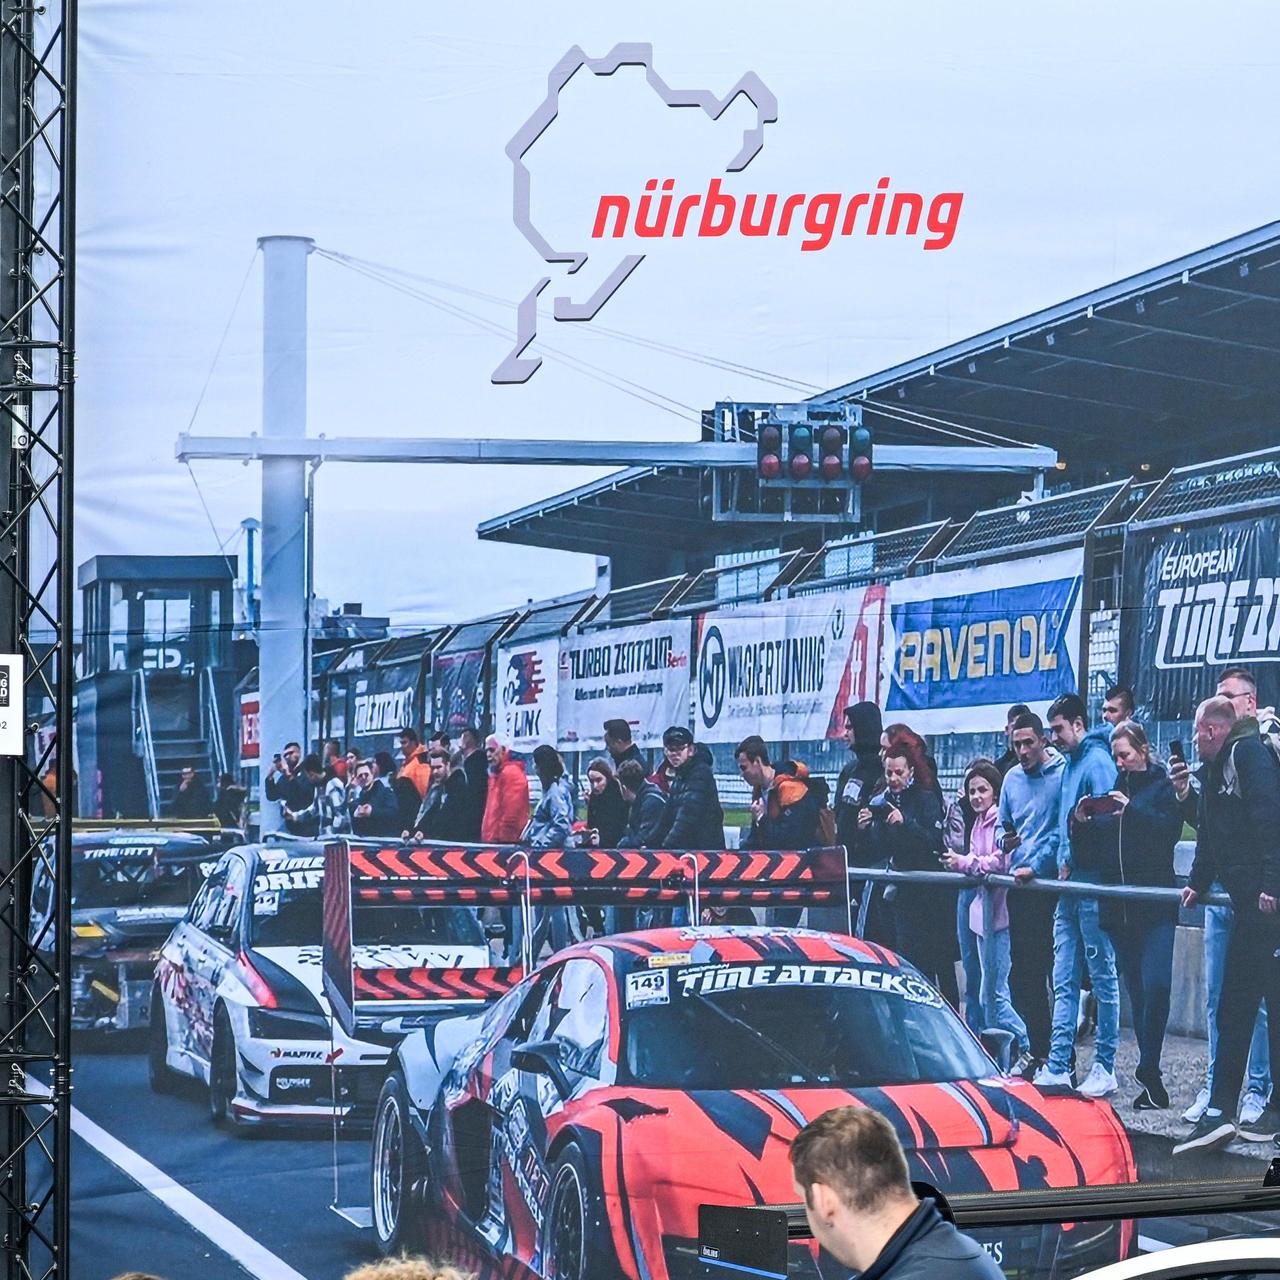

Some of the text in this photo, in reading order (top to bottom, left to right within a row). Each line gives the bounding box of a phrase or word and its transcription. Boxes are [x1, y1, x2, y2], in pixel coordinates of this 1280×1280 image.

[592, 177, 963, 251] nürburgring
[1162, 548, 1238, 581] EUROPEAN
[570, 644, 612, 680] TURBO
[900, 612, 1058, 684] RAVENOL
[630, 974, 665, 992] 149
